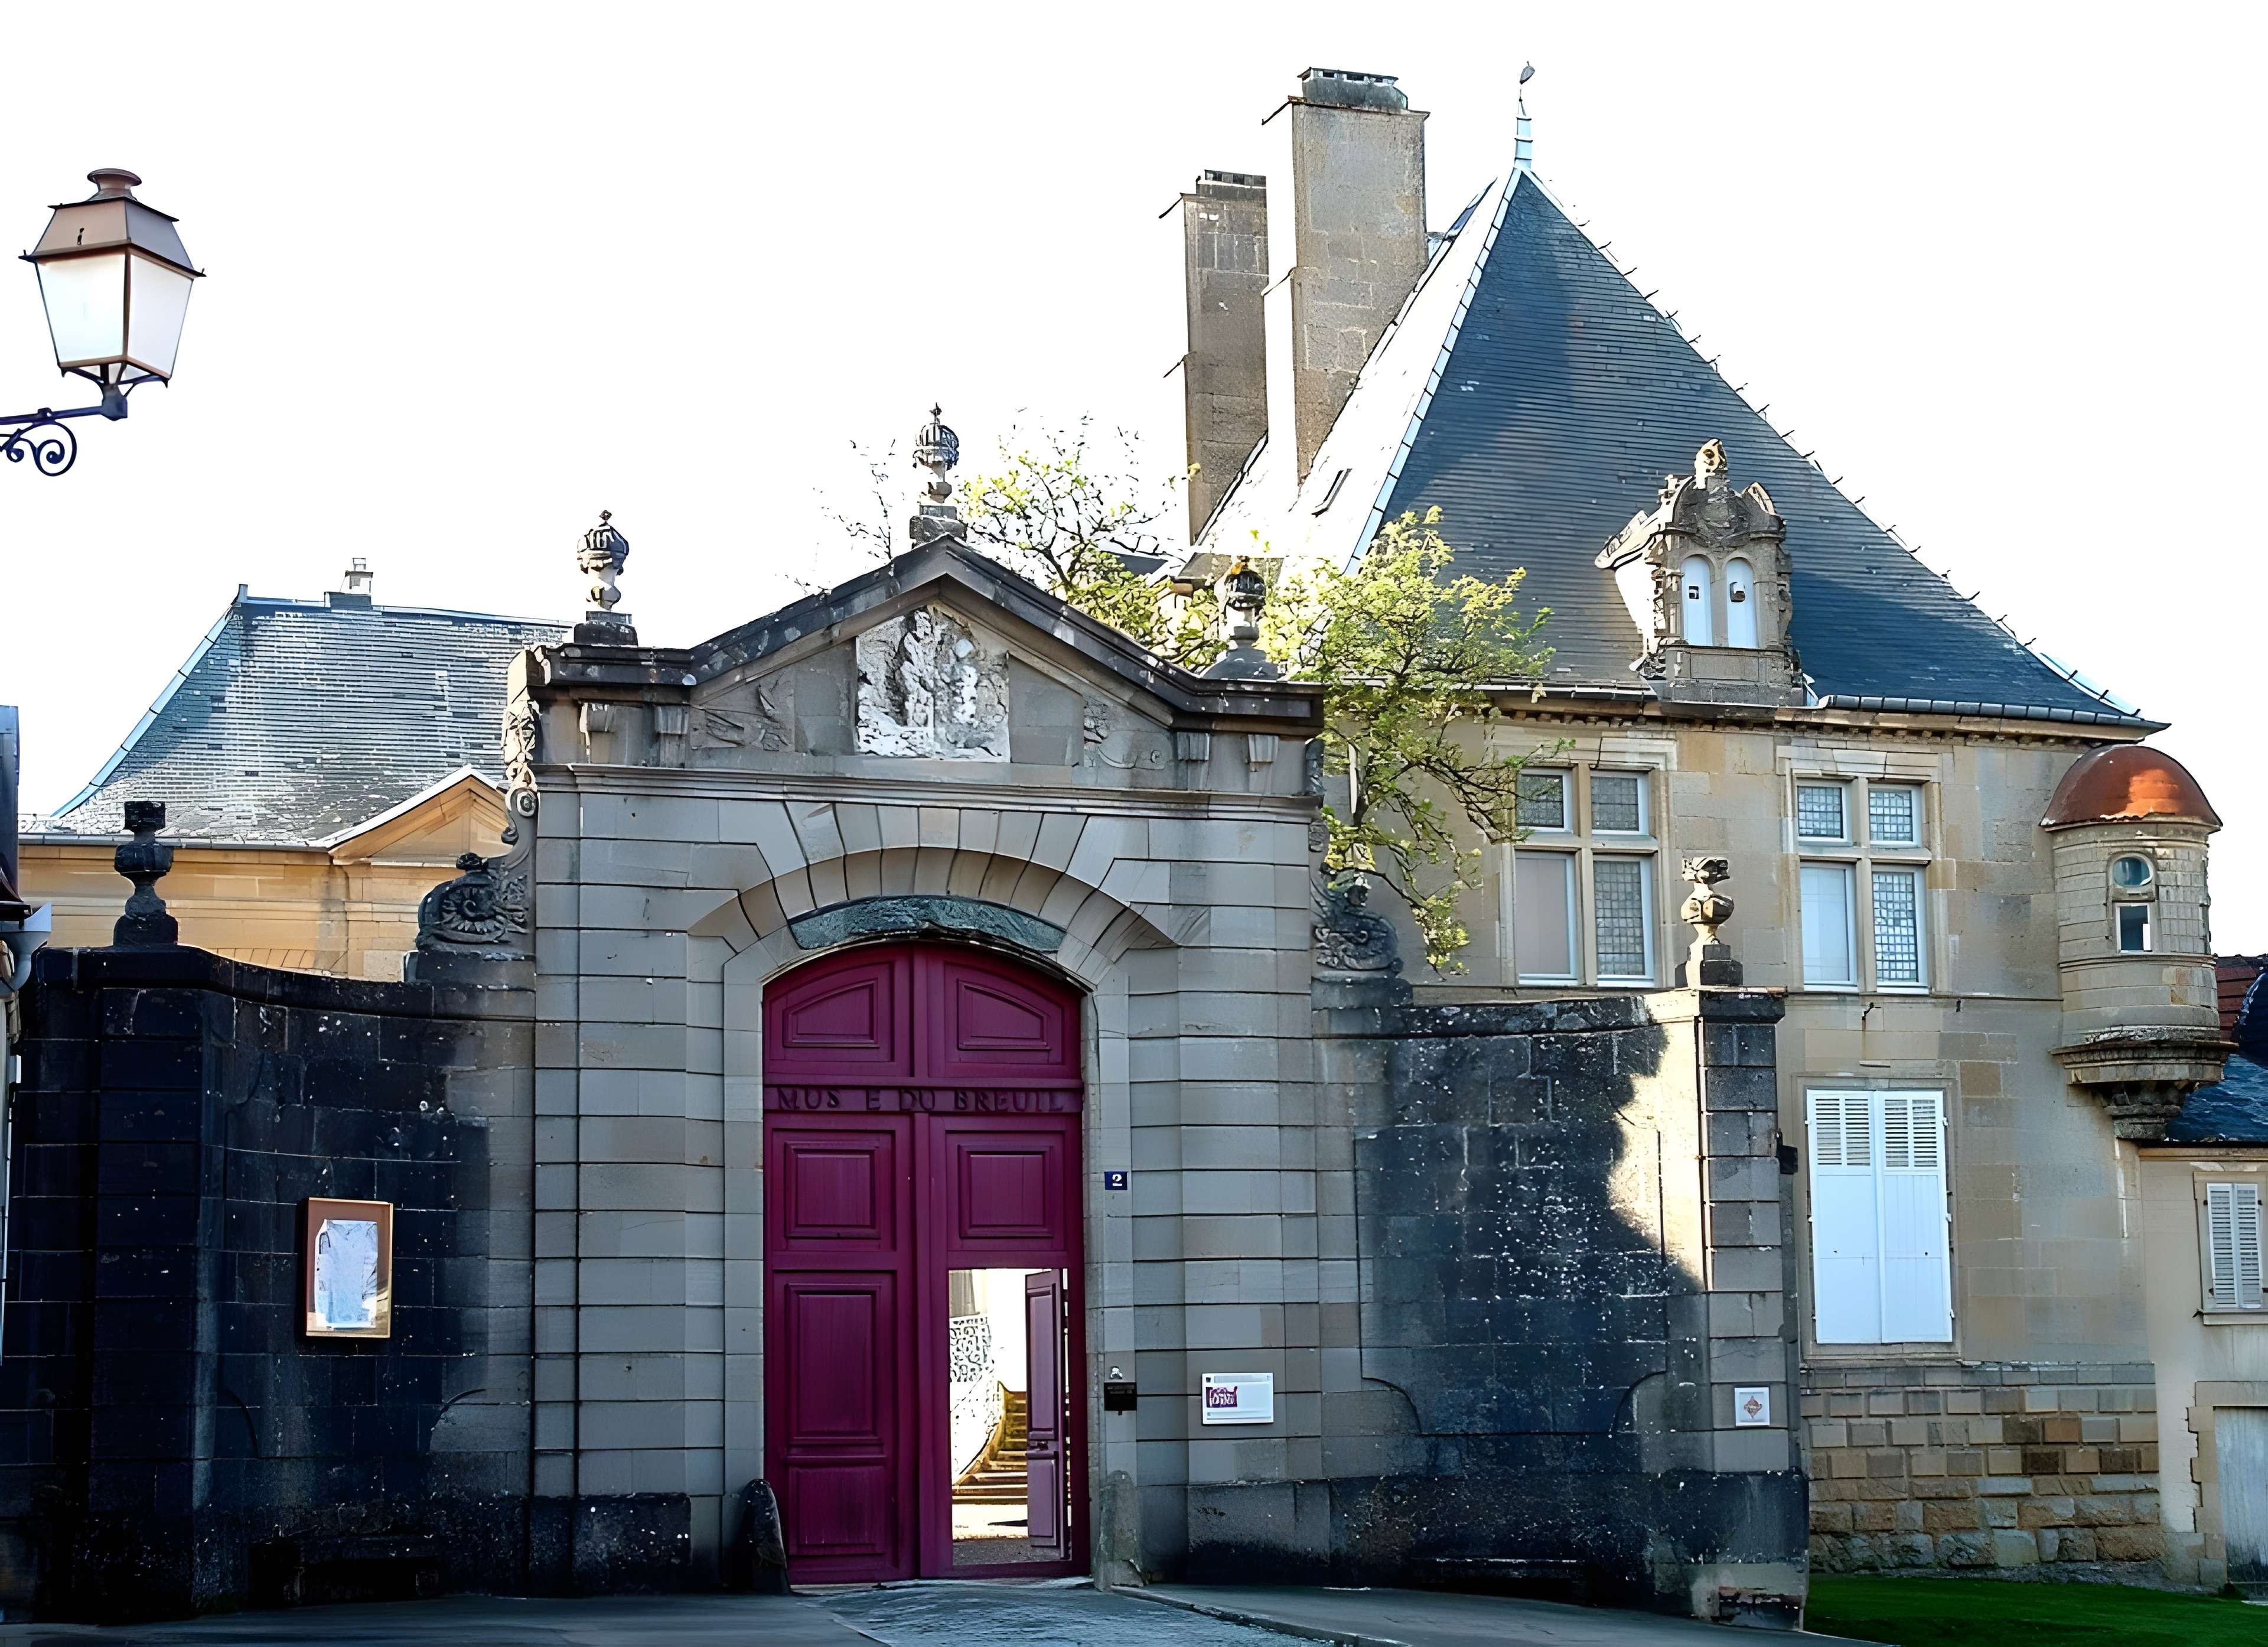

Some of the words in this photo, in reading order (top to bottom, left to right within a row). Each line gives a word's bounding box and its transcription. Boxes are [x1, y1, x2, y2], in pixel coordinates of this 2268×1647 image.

[777, 1087, 881, 1110] MUSE
[899, 1089, 935, 1111] DU
[954, 1090, 1064, 1112] BREUIL
[1112, 1174, 1123, 1187] 2
